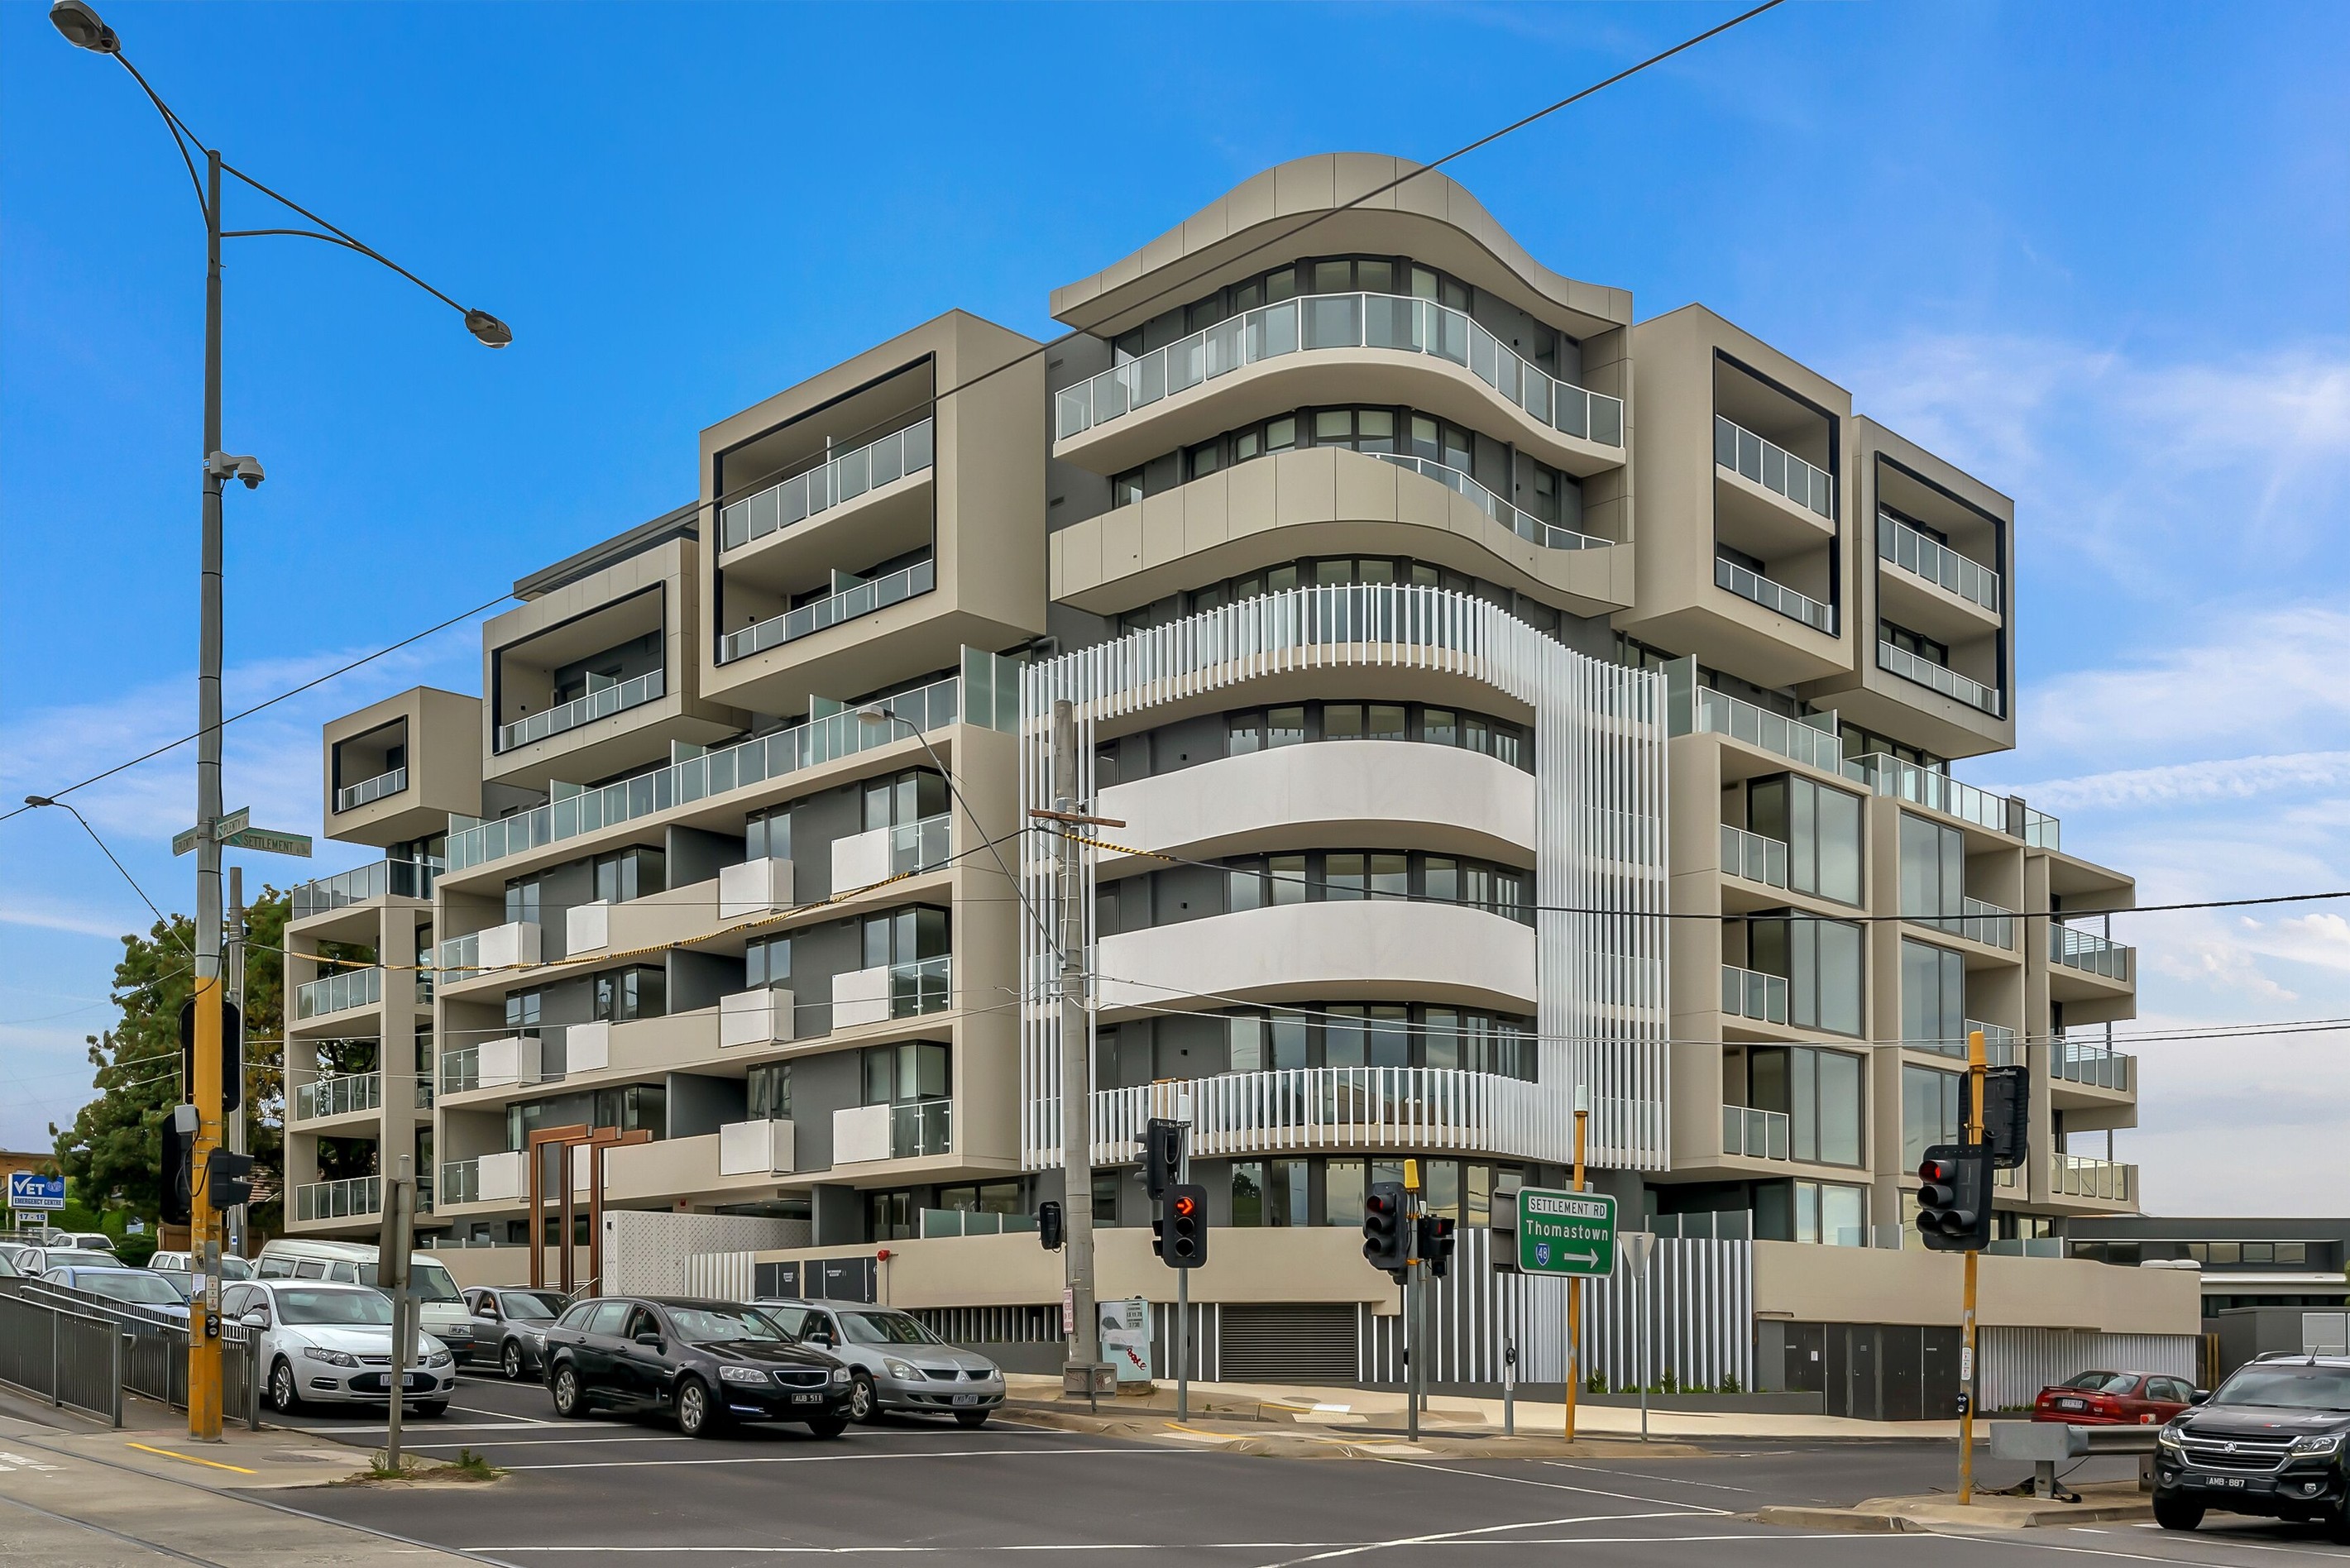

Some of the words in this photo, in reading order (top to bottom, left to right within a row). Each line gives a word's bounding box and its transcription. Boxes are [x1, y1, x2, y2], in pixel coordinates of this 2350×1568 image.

[223, 820, 241, 834] PLENTY
[177, 838, 194, 852] PLENTY
[243, 834, 294, 852] SETTLEMENT
[14, 1176, 45, 1195] VET
[1530, 1198, 1589, 1216] SETTLEMENT
[1593, 1204, 1606, 1217] RD
[1525, 1220, 1608, 1241] Thomastown
[1538, 1246, 1548, 1260] 48
[795, 1394, 807, 1403] AUB
[810, 1394, 821, 1403] 511
